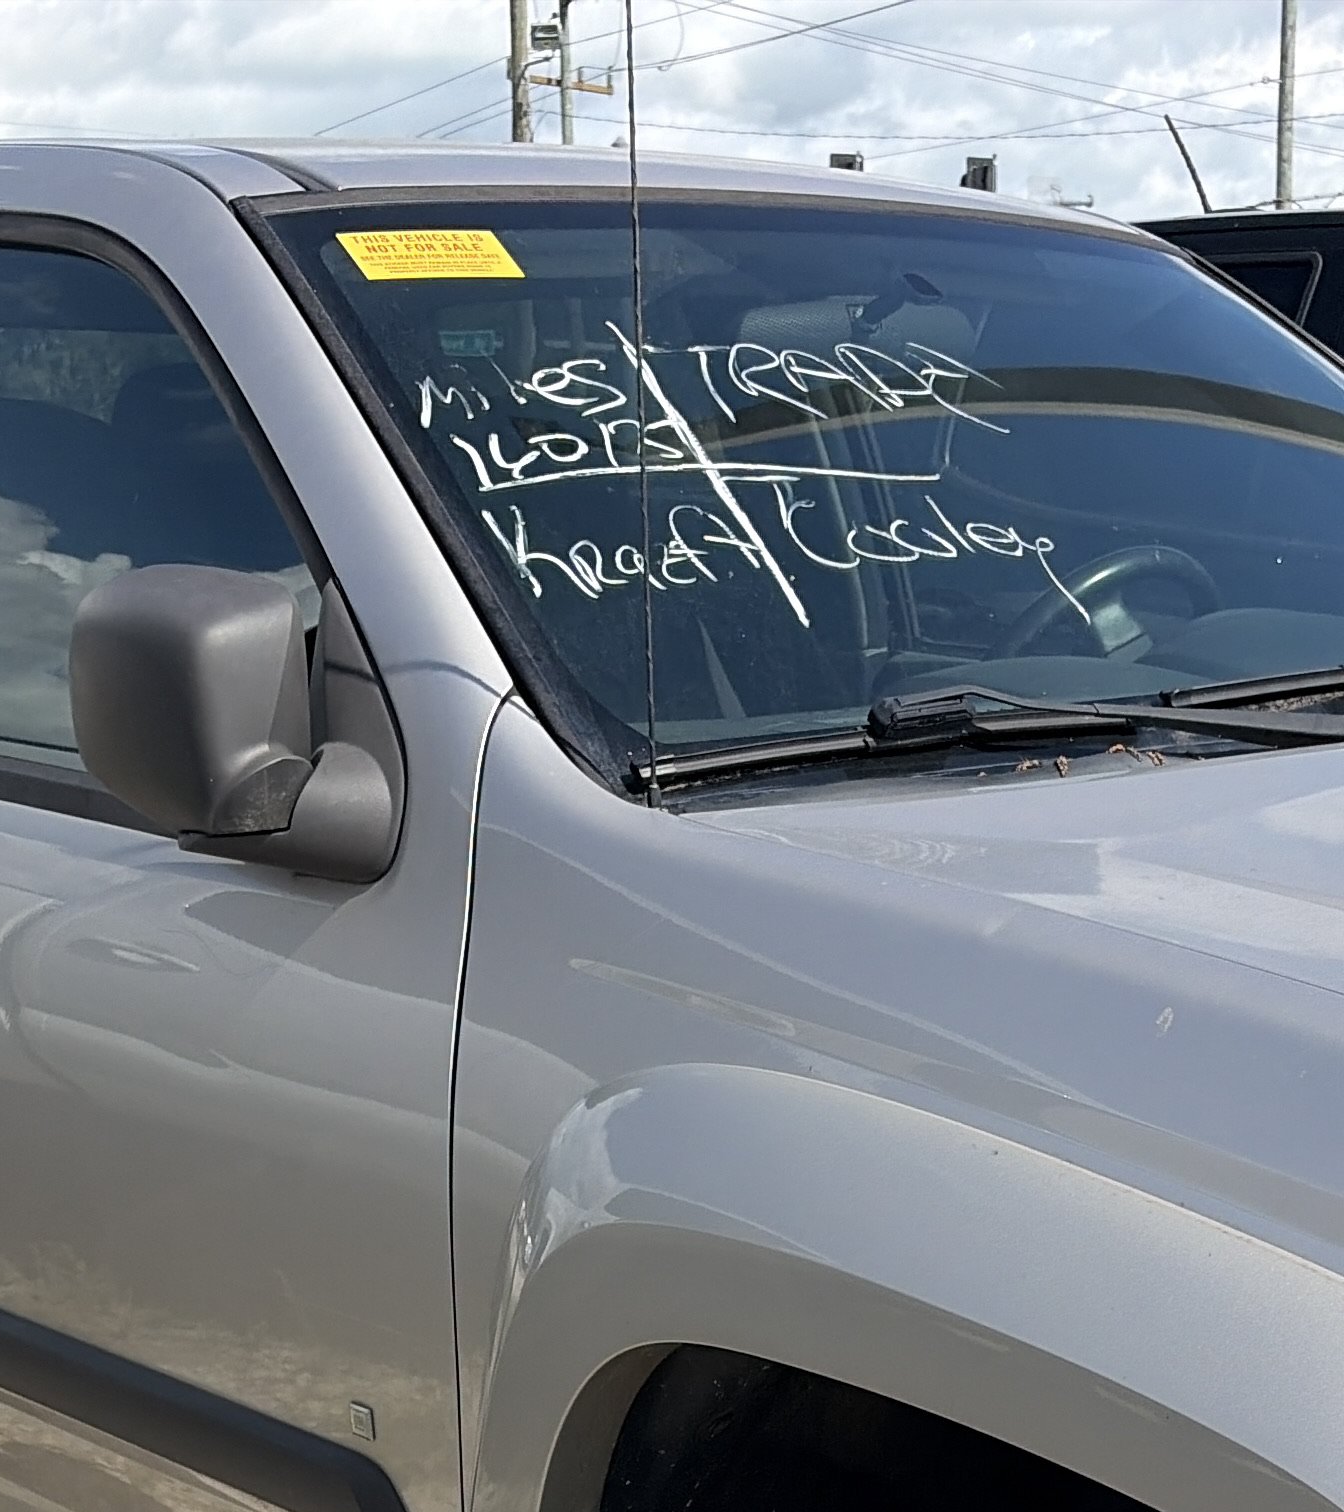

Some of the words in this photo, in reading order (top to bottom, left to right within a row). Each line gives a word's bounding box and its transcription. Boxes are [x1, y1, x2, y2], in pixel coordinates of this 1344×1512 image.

[350, 234, 390, 244] THIS
[393, 233, 464, 242] VEHICLE
[467, 233, 484, 242] IS
[365, 244, 397, 253] NOT
[404, 243, 437, 252] FOR
[441, 243, 483, 252] SALE
